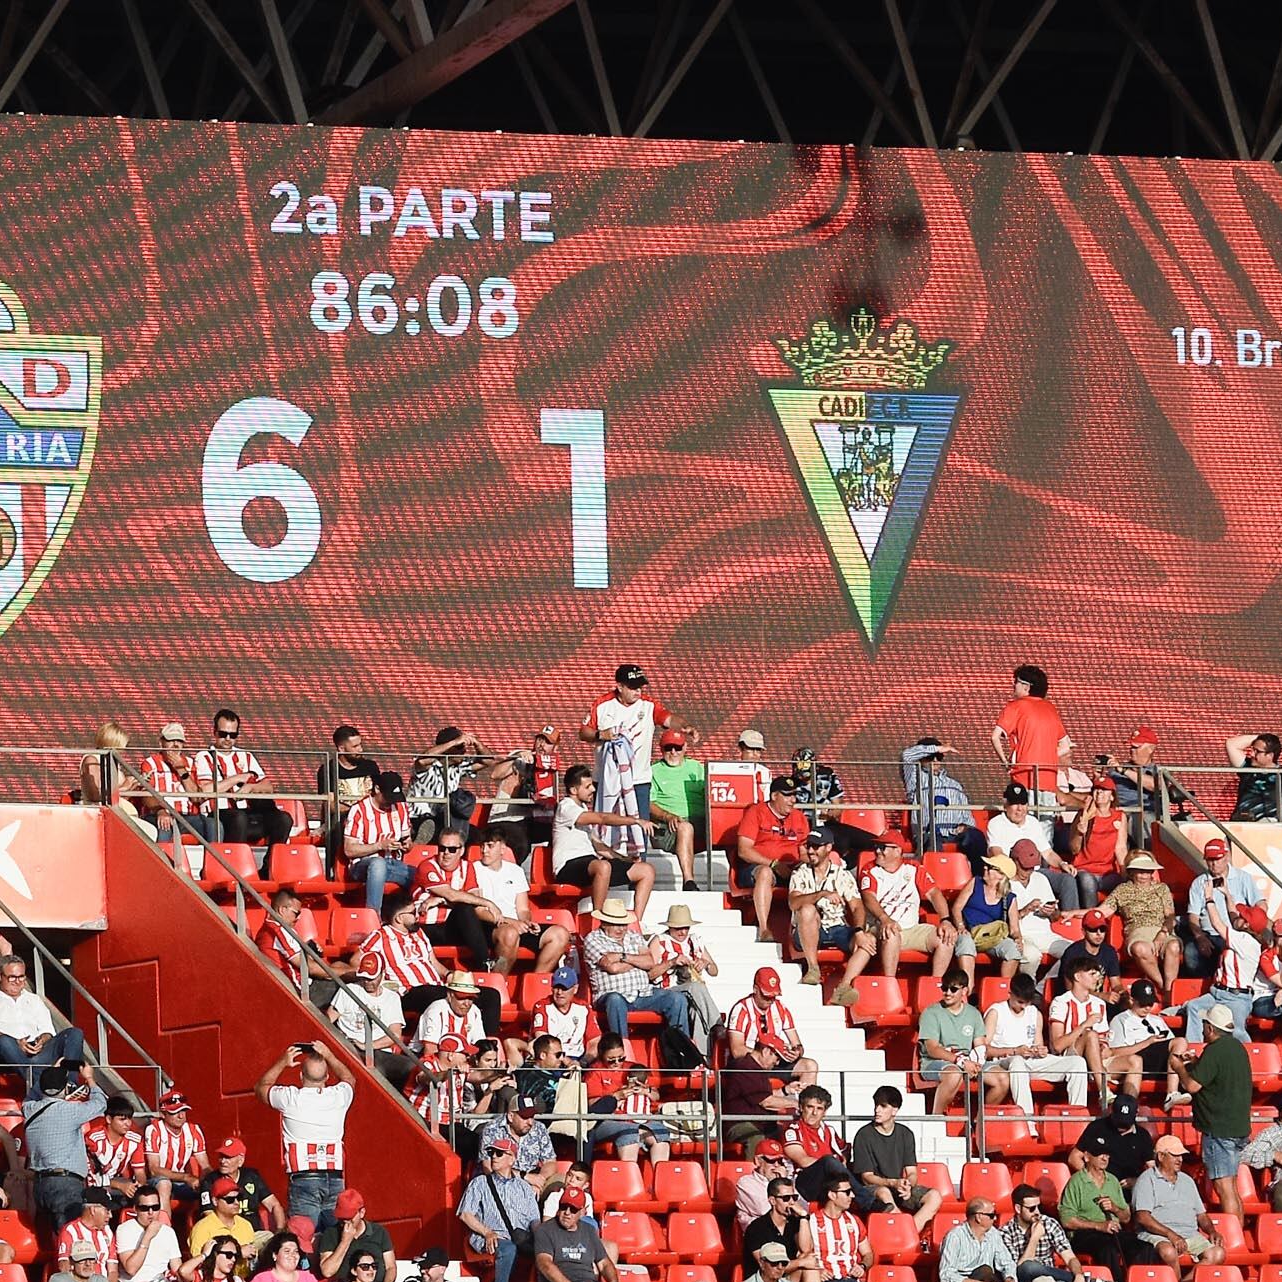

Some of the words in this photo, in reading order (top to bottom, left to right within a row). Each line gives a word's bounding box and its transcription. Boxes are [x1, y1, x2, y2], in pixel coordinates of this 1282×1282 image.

[269, 181, 338, 235] 2a
[359, 185, 555, 243] PARTE
[309, 271, 519, 340] 86:08
[1171, 326, 1223, 366] 10.
[22, 358, 72, 398] D
[819, 395, 877, 418] CADI
[202, 396, 322, 584] 6
[540, 408, 610, 589] 1
[711, 787, 736, 802] 134
